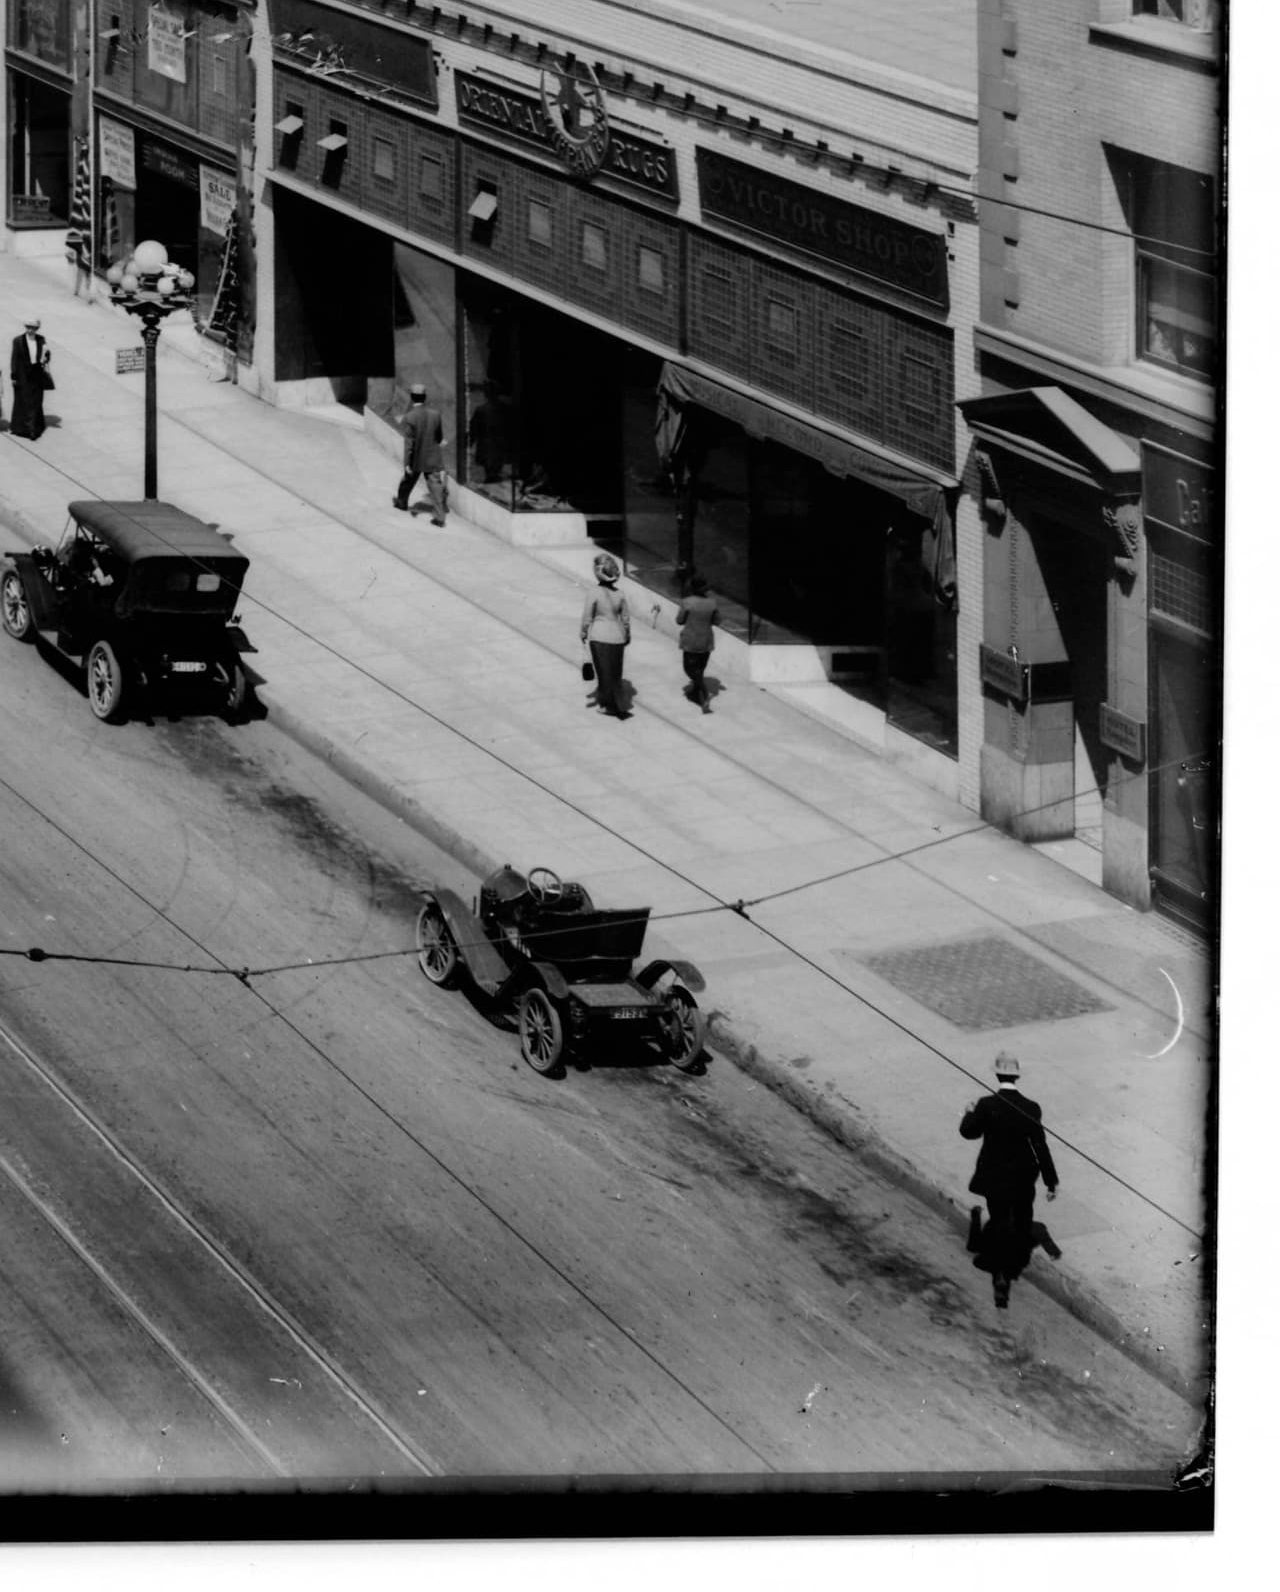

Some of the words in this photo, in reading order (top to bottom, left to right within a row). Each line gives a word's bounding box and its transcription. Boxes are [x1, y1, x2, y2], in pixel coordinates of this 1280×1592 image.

[611, 136, 668, 184] RUGS
[207, 181, 231, 203] SALE
[727, 174, 830, 239] VICTOR
[834, 217, 910, 267] SHOP
